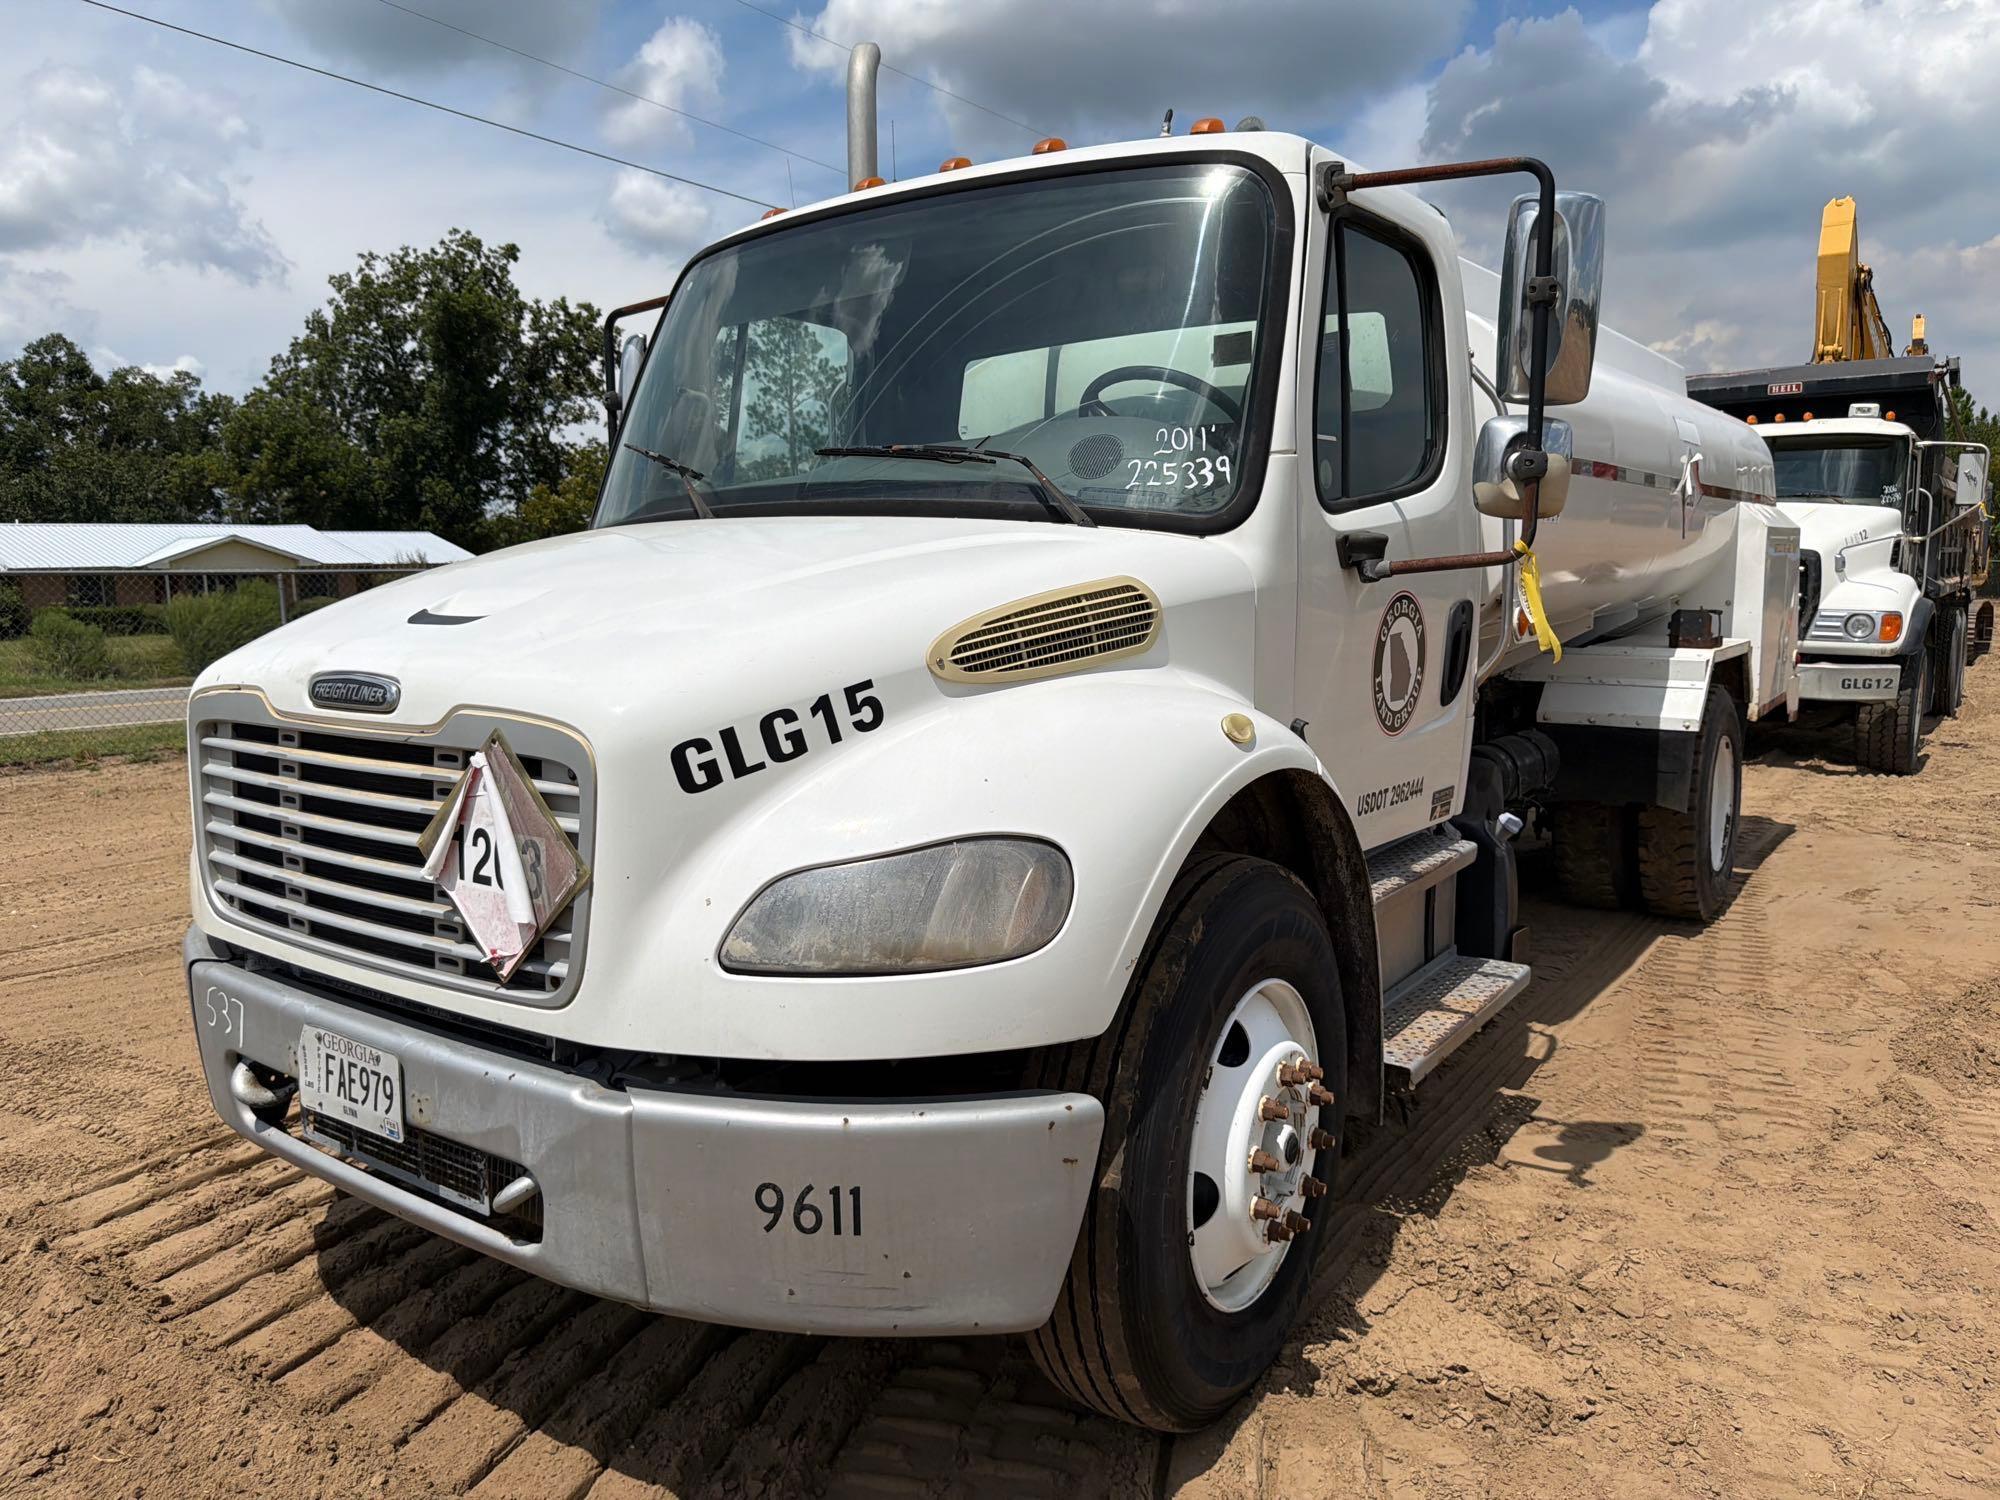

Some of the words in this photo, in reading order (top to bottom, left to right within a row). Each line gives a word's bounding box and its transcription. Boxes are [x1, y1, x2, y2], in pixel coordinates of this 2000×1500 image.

[1771, 384, 1799, 393] HEIL
[1125, 455, 1231, 490] 225339
[1380, 599, 1423, 642] GEORGIA
[313, 682, 385, 703] FREIGHTLINER
[1375, 673, 1393, 727] LAND
[1394, 666, 1422, 728] GROUP
[1841, 678, 1894, 690] GLG12
[670, 678, 885, 795] GLG15
[1357, 787, 1390, 817] USDOT
[1389, 776, 1425, 806] 2962444
[206, 986, 245, 1049] 537
[322, 1032, 378, 1066] GEORGIA
[325, 1052, 394, 1115] FAE979
[754, 1182, 862, 1236] 9611
